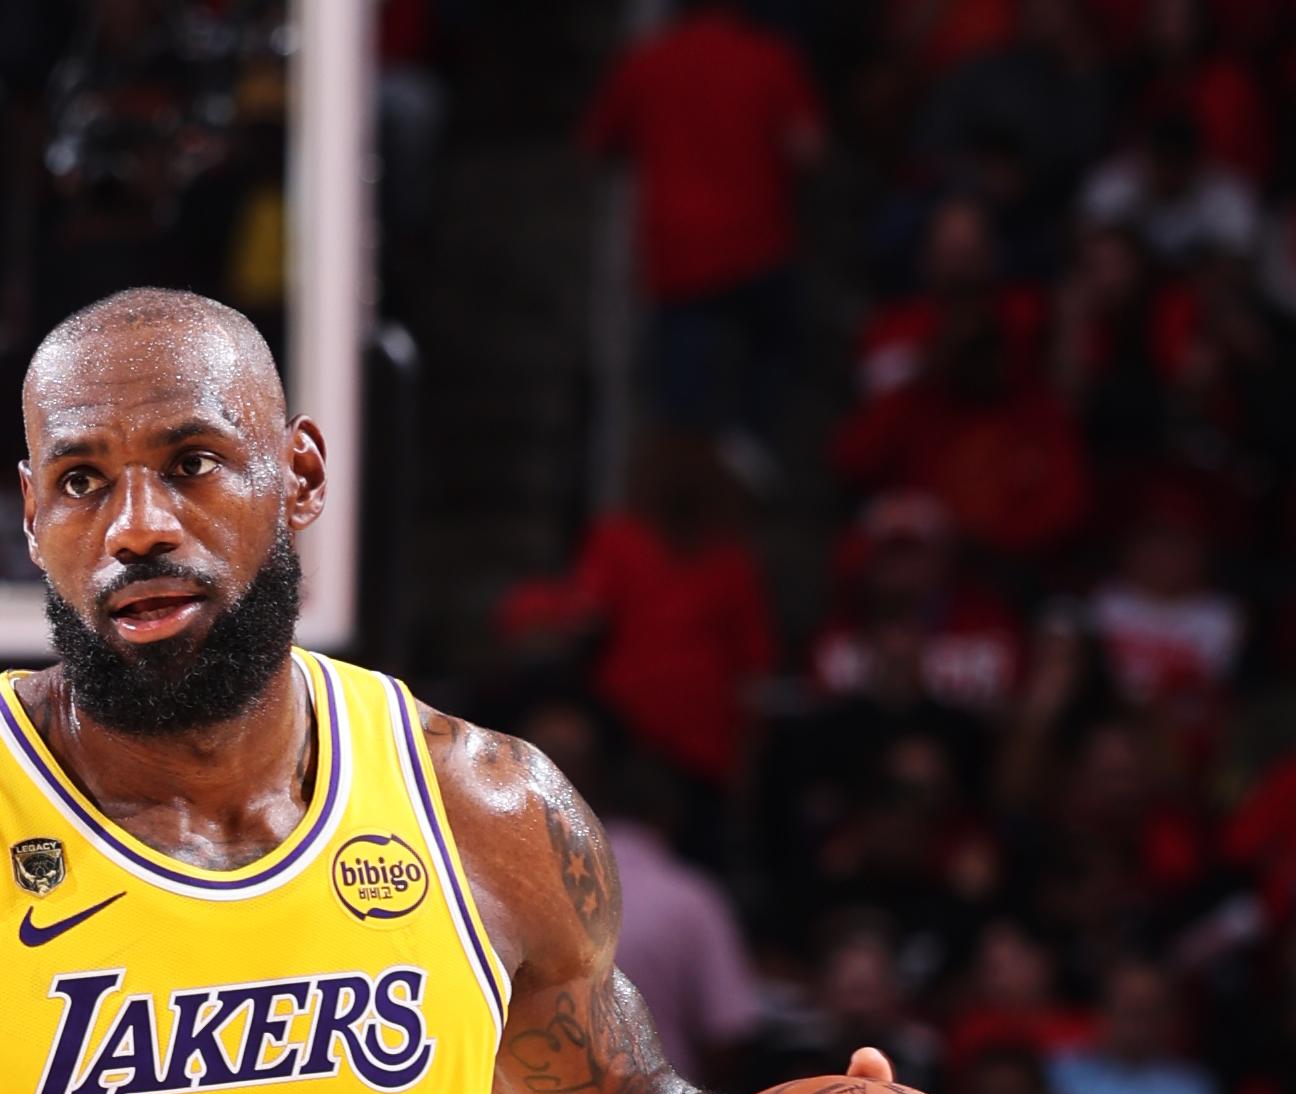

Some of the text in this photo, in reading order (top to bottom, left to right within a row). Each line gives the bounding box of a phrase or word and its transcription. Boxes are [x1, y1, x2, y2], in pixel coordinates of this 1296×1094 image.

[15, 842, 58, 853] LEGACY
[339, 856, 422, 892] bibigo
[357, 886, 393, 901] 비비고
